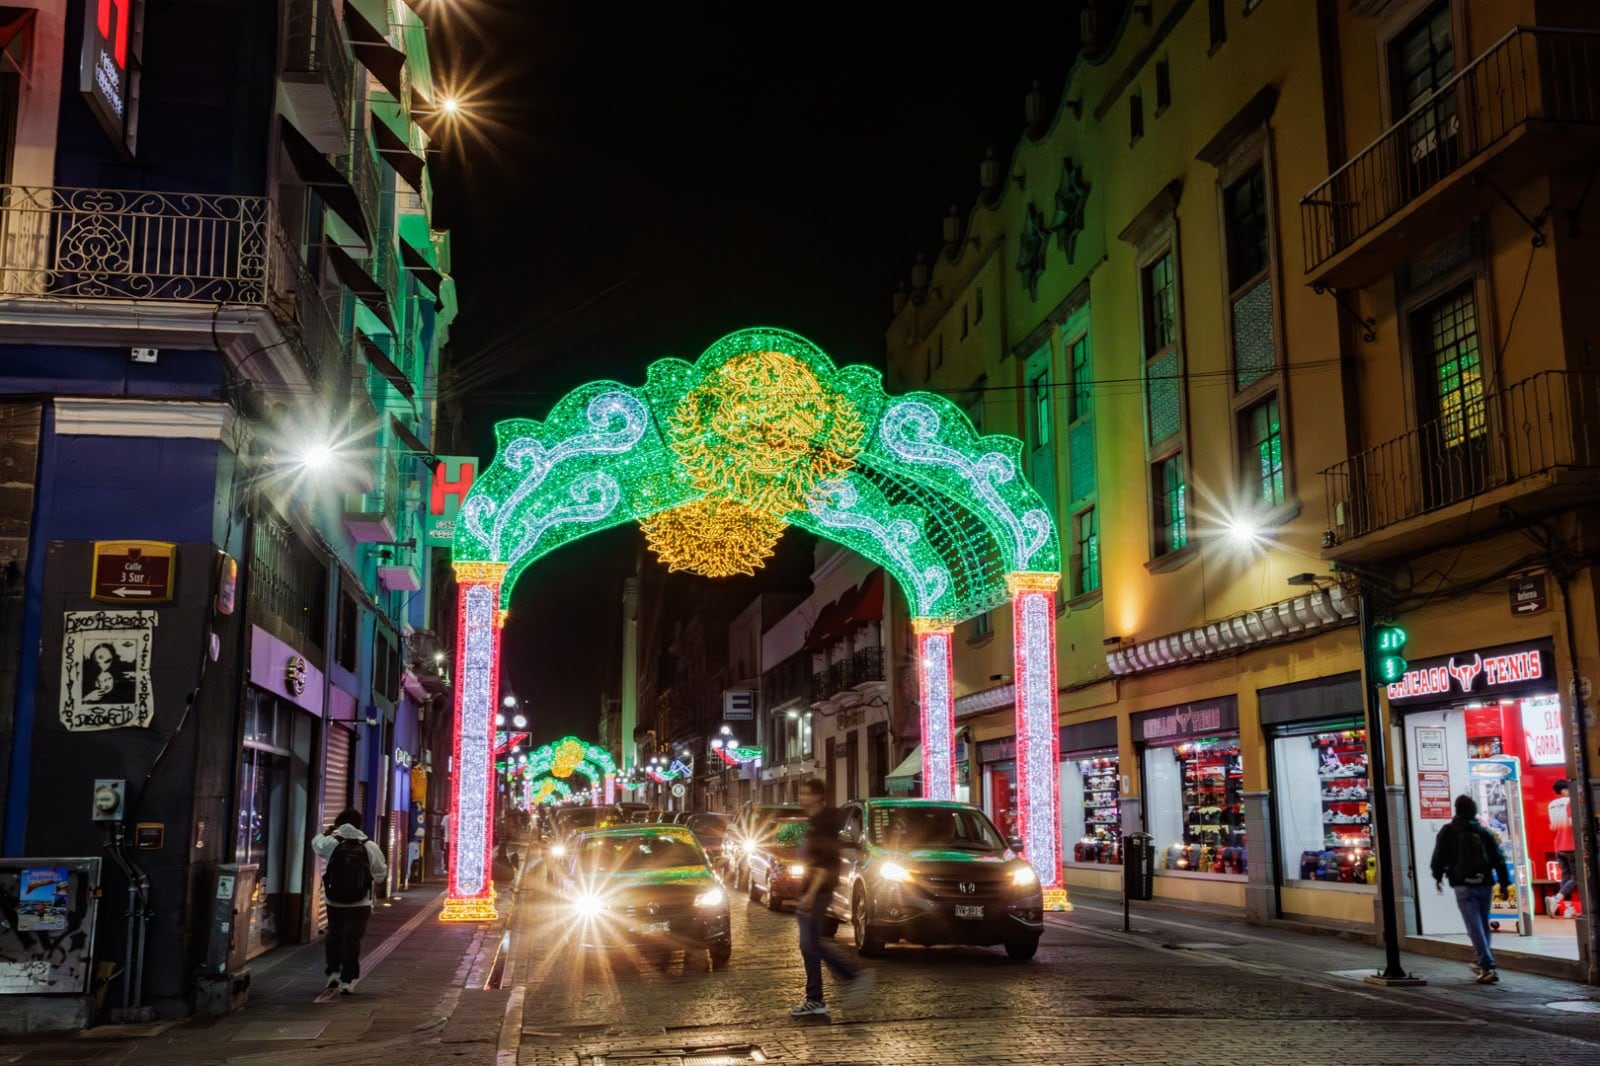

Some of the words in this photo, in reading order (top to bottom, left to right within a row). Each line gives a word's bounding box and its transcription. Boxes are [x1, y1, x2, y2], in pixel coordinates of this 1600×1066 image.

[124, 562, 142, 571] Calle
[120, 572, 127, 582] 3
[128, 572, 145, 583] Sur
[1387, 667, 1450, 699] CHICAGO
[1483, 650, 1543, 686] TENIS
